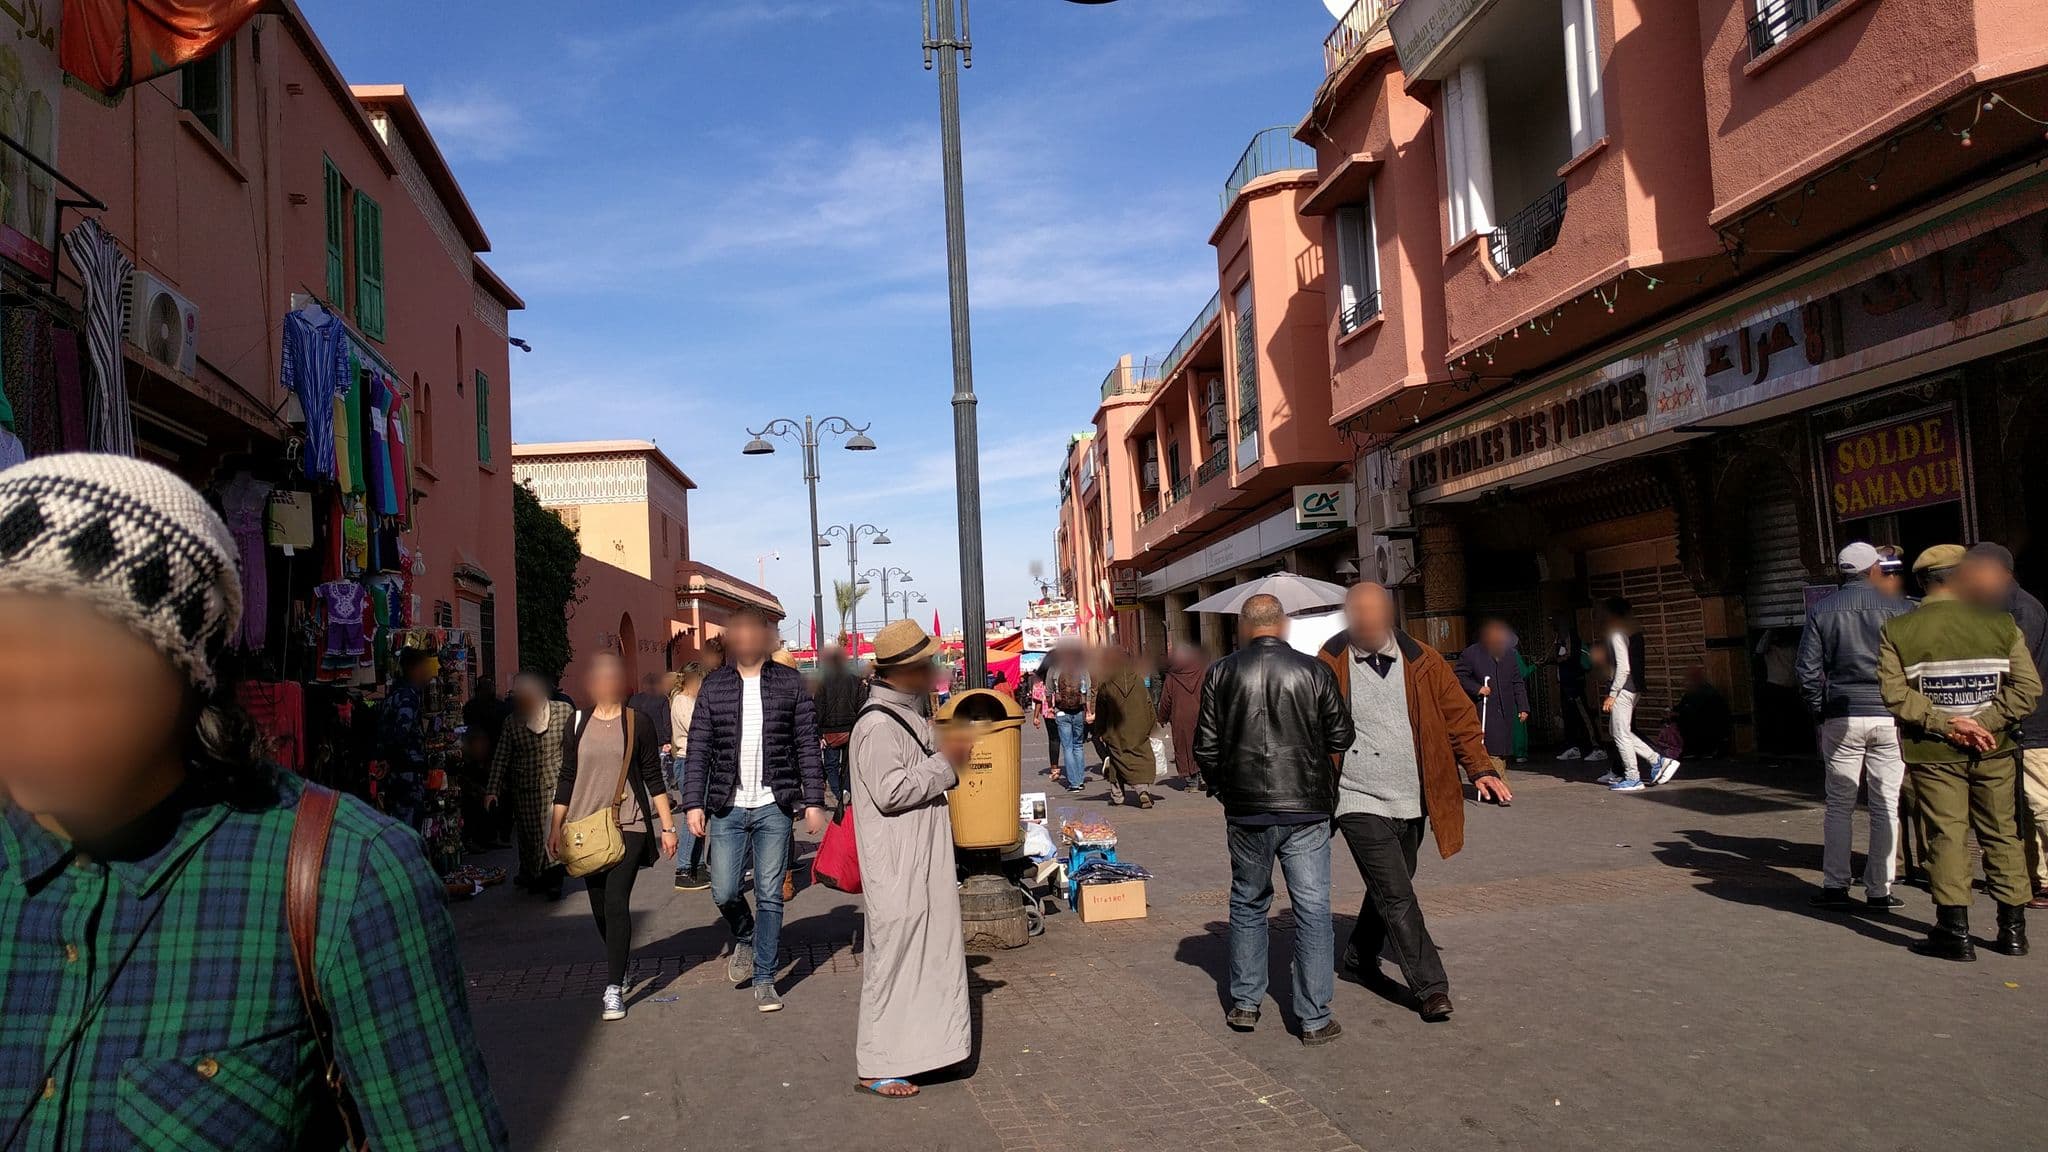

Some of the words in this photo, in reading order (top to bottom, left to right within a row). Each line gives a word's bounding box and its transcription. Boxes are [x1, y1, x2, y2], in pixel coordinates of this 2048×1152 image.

[1409, 451, 1437, 491] LES
[1440, 427, 1505, 481] PERLES
[1509, 411, 1547, 458] DES
[1552, 372, 1649, 444] PRINCES
[1837, 416, 1945, 475] SOLDE
[1303, 490, 1339, 513] CA
